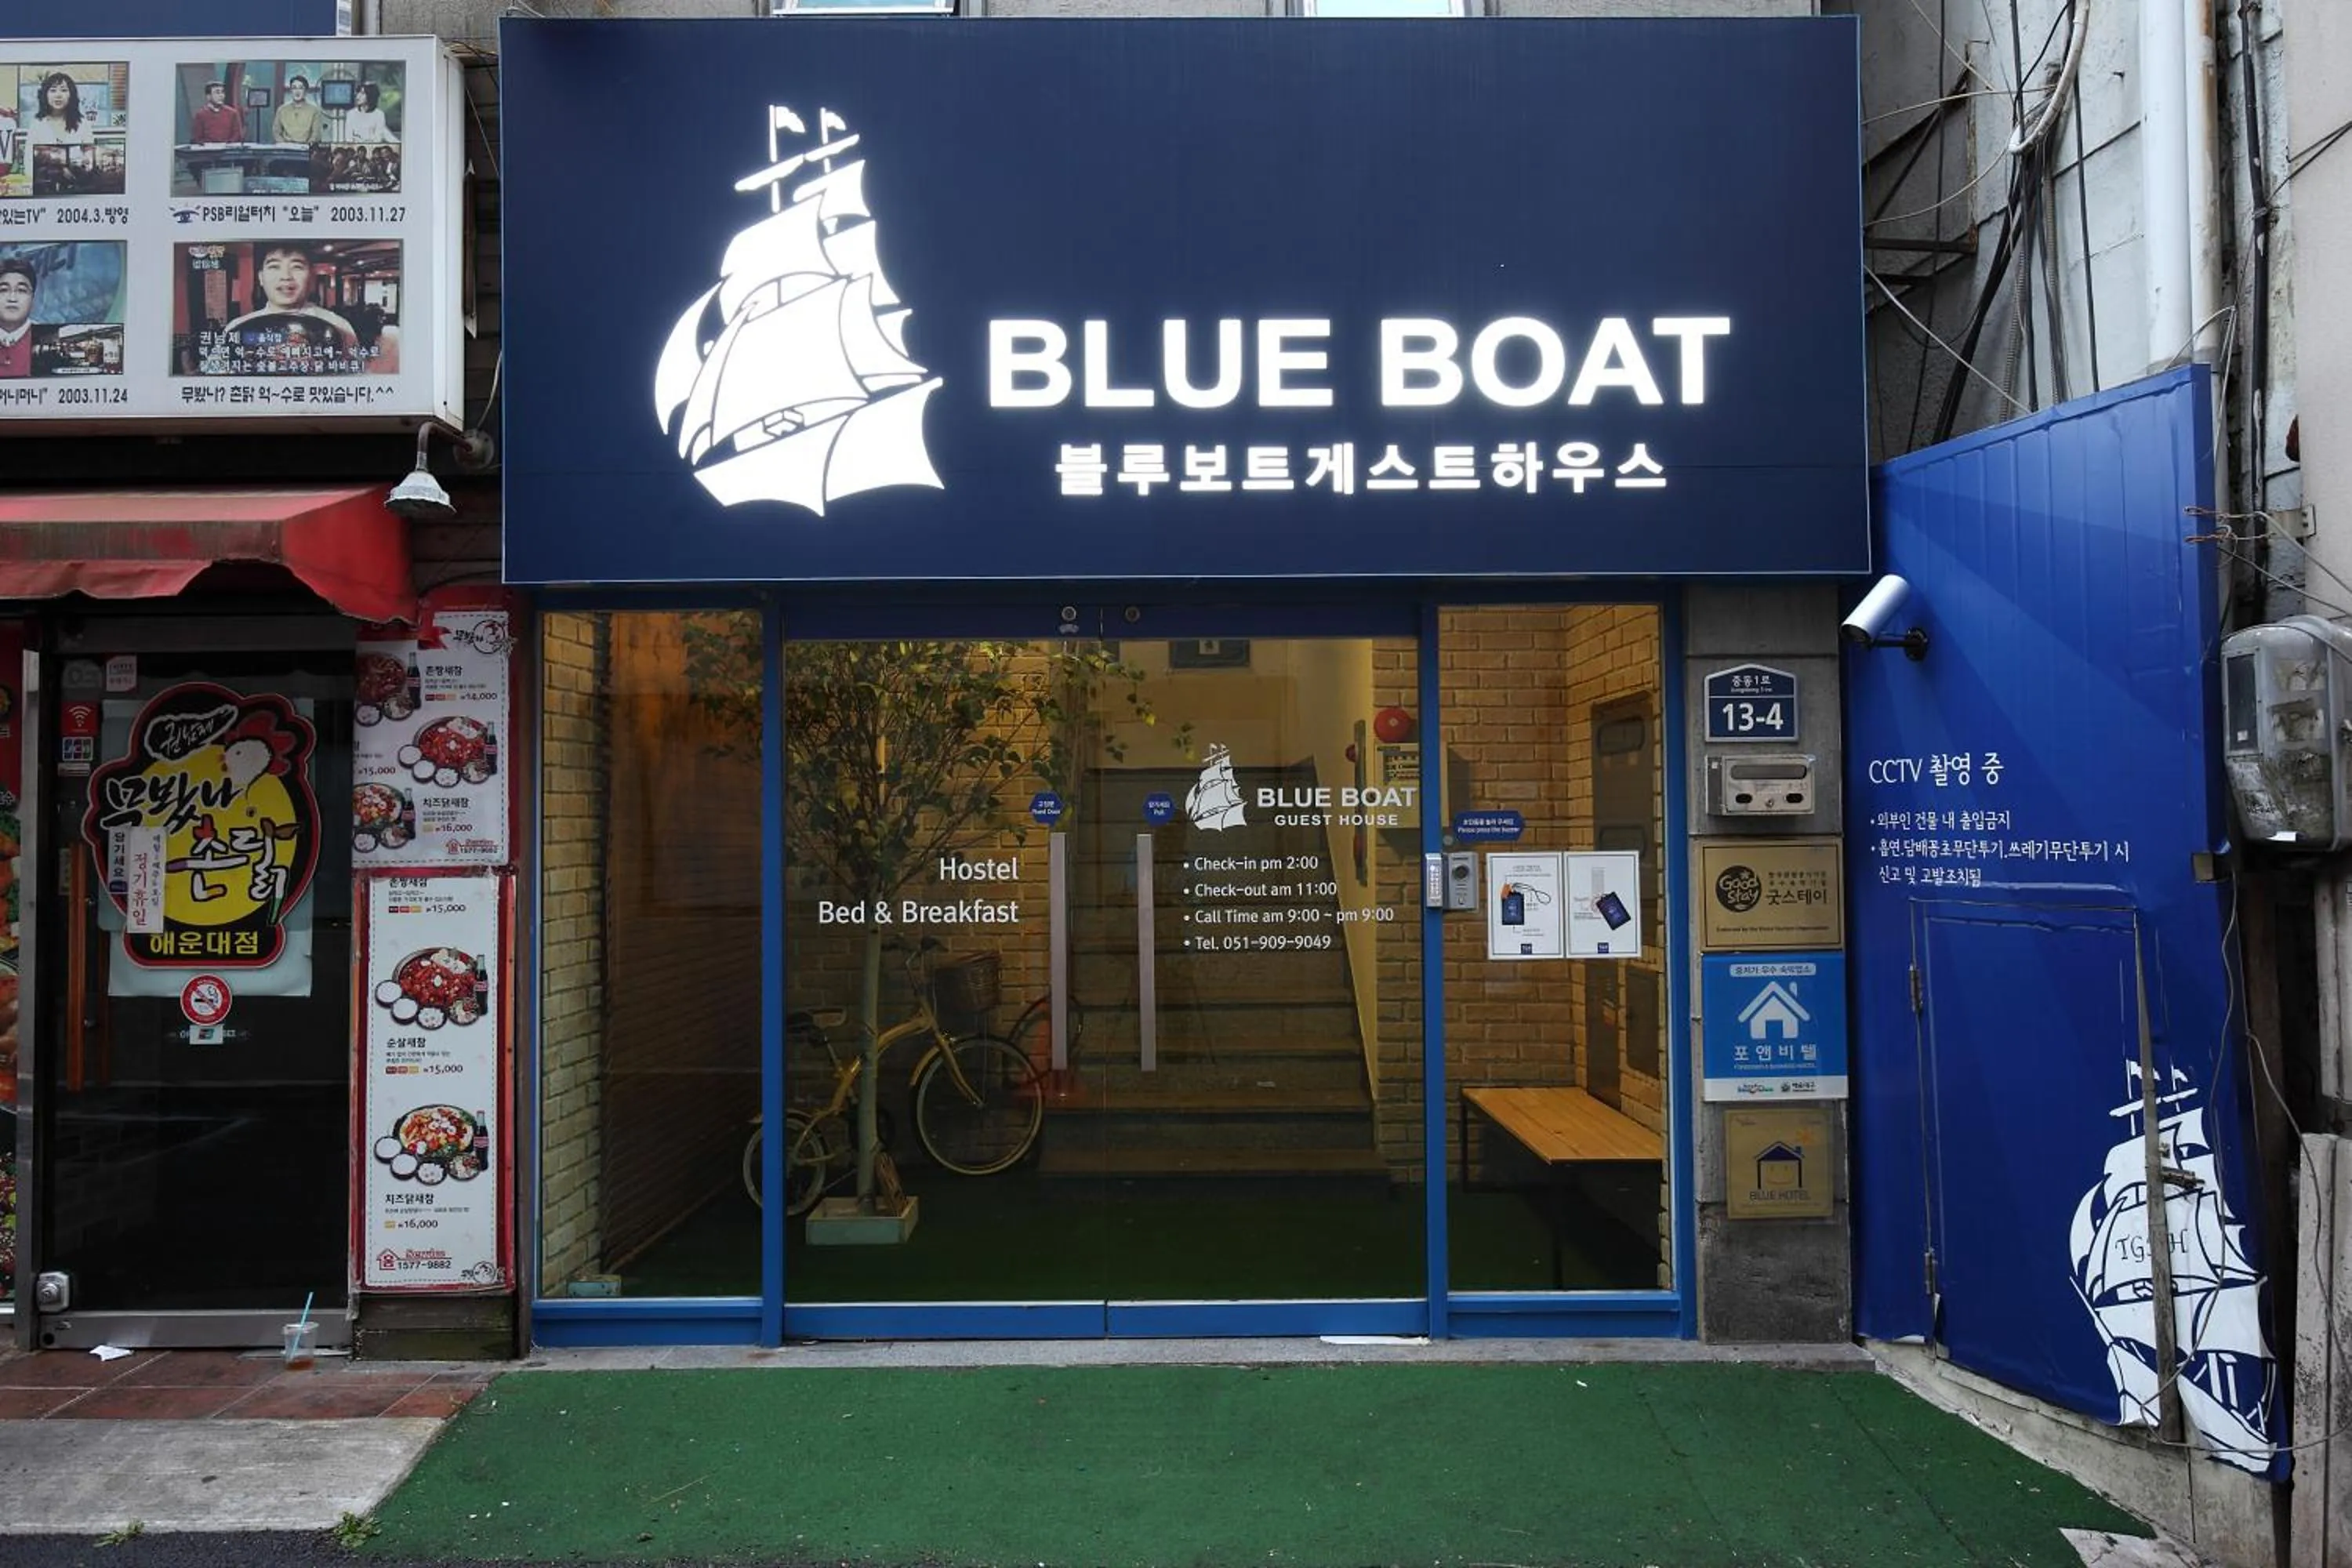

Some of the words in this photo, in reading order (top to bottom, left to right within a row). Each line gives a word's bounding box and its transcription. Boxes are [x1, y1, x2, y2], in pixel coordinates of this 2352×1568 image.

[0, 207, 46, 225] 있는TV"
[57, 207, 129, 225] 2004.3.방영
[202, 205, 275, 223] PSB리얼터치
[330, 206, 405, 223] 2003.11.27
[990, 319, 1334, 408] BLUE
[1380, 317, 1730, 407] BOAT
[58, 388, 129, 405] 2003.11.24
[230, 387, 256, 404] 촌닭
[258, 386, 306, 402] 억~수로
[1055, 442, 1668, 495] 블루보트게스트하우스
[1732, 675, 1772, 688] 중동1로
[1722, 702, 1784, 731] 13-4
[1868, 758, 1923, 784] CCTV
[1929, 752, 1972, 786] 촬영
[1981, 752, 2005, 786] 중
[1257, 788, 1332, 808] BLUE
[1341, 787, 1418, 807] BOAT
[1274, 814, 1333, 826] GUEST
[1338, 814, 1398, 826] HOUSE
[1877, 811, 1911, 830] 외부인
[1915, 811, 1939, 830] 건물
[1941, 811, 1955, 830] 내
[1959, 810, 2011, 831] 출입금지
[2114, 840, 2130, 862] 시
[939, 857, 1020, 881] Hostel
[1193, 855, 1257, 871] Check-in
[1261, 858, 1283, 873] pm
[1286, 855, 1319, 870] 2:00
[1718, 869, 1759, 891] Good
[1879, 866, 1901, 884] 신고
[1904, 866, 1916, 885] 및
[1920, 867, 1982, 888] 고발조치됨
[132, 852, 149, 926] 정기휴일
[1194, 883, 1268, 898] Check-out
[1270, 885, 1292, 897] am
[1297, 881, 1338, 897] 11:00
[1766, 888, 1828, 906] 굿스테이
[818, 901, 866, 924] Bed
[874, 901, 893, 924] &
[902, 900, 1020, 924] Breakfast
[1194, 909, 1221, 924] Call
[1223, 908, 1259, 924] Time
[1261, 911, 1284, 923] am
[1287, 908, 1320, 923] 9:00
[1336, 910, 1358, 924] pm
[1362, 907, 1395, 922] 9:00
[149, 931, 259, 955] 해운대점
[1194, 935, 1220, 950] Tel.
[1222, 935, 1332, 950] 051-909-9049
[1733, 1043, 1817, 1062] 포앤비텔
[2114, 1229, 2189, 1263] TGH
